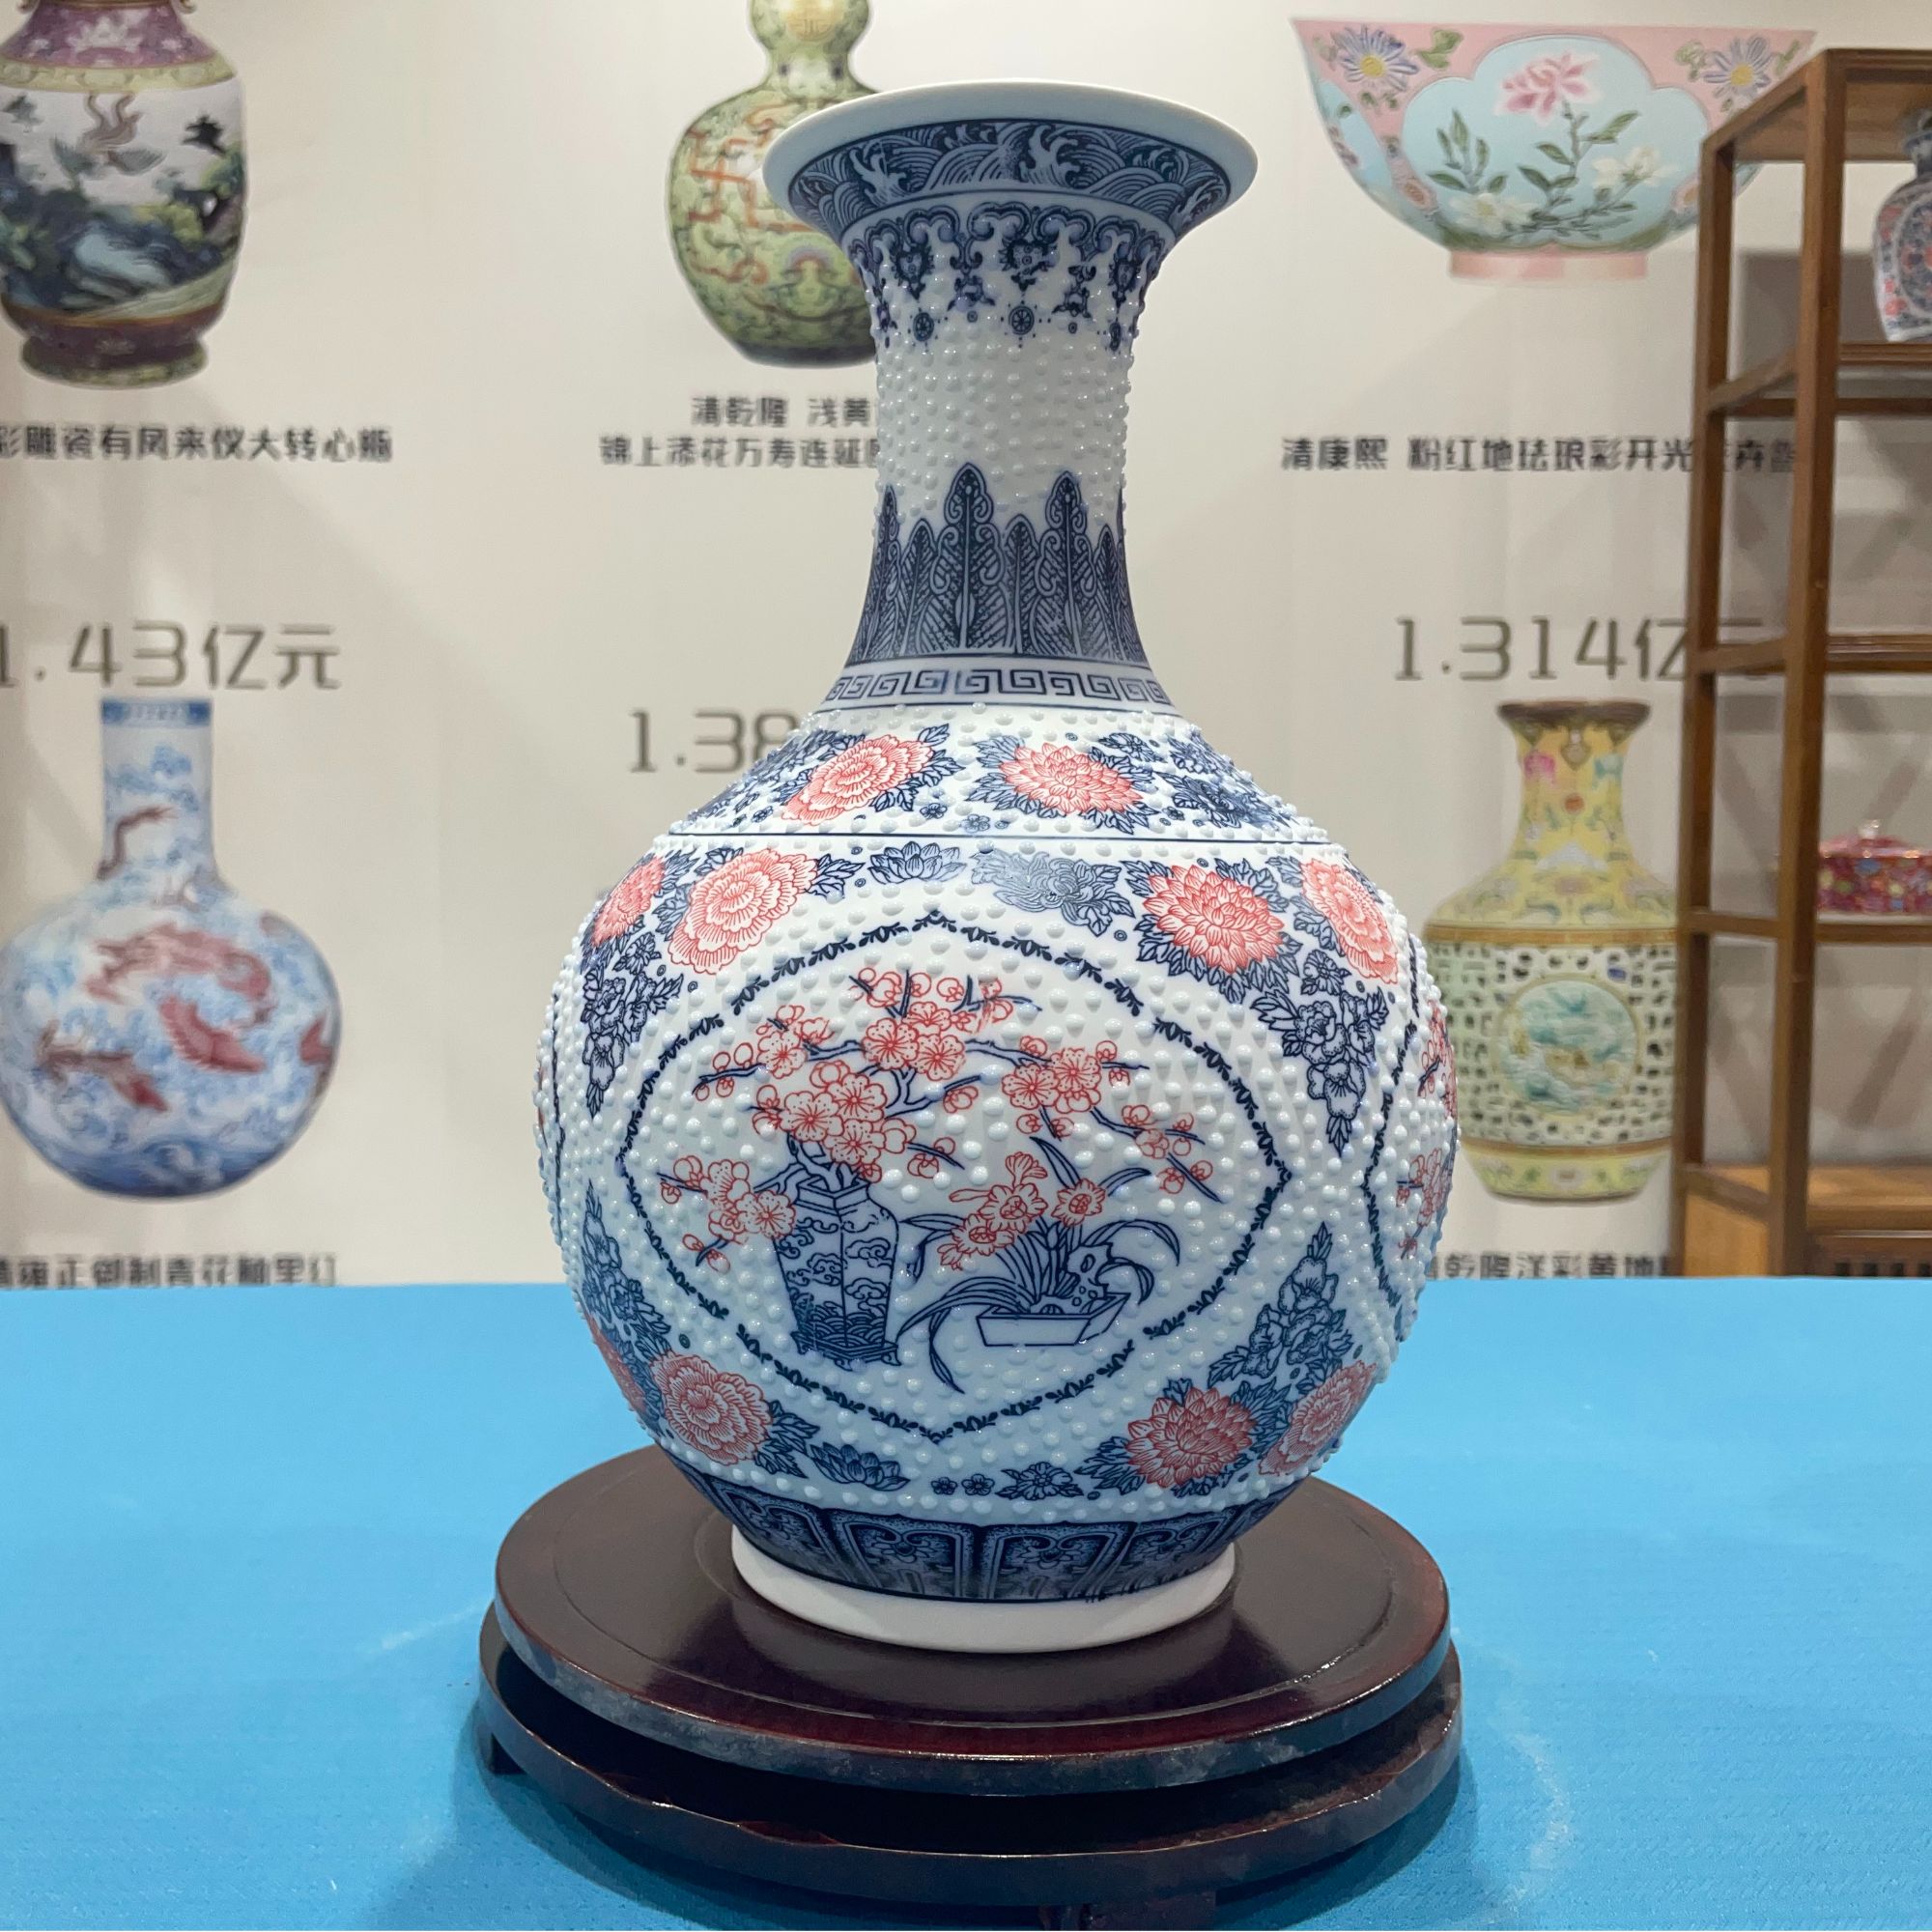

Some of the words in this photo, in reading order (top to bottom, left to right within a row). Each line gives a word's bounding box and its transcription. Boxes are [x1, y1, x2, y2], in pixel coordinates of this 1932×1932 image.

[691, 396, 788, 428] 清乾隆
[1282, 437, 1388, 470] 清康熙
[0, 619, 340, 688] 1.43亿元
